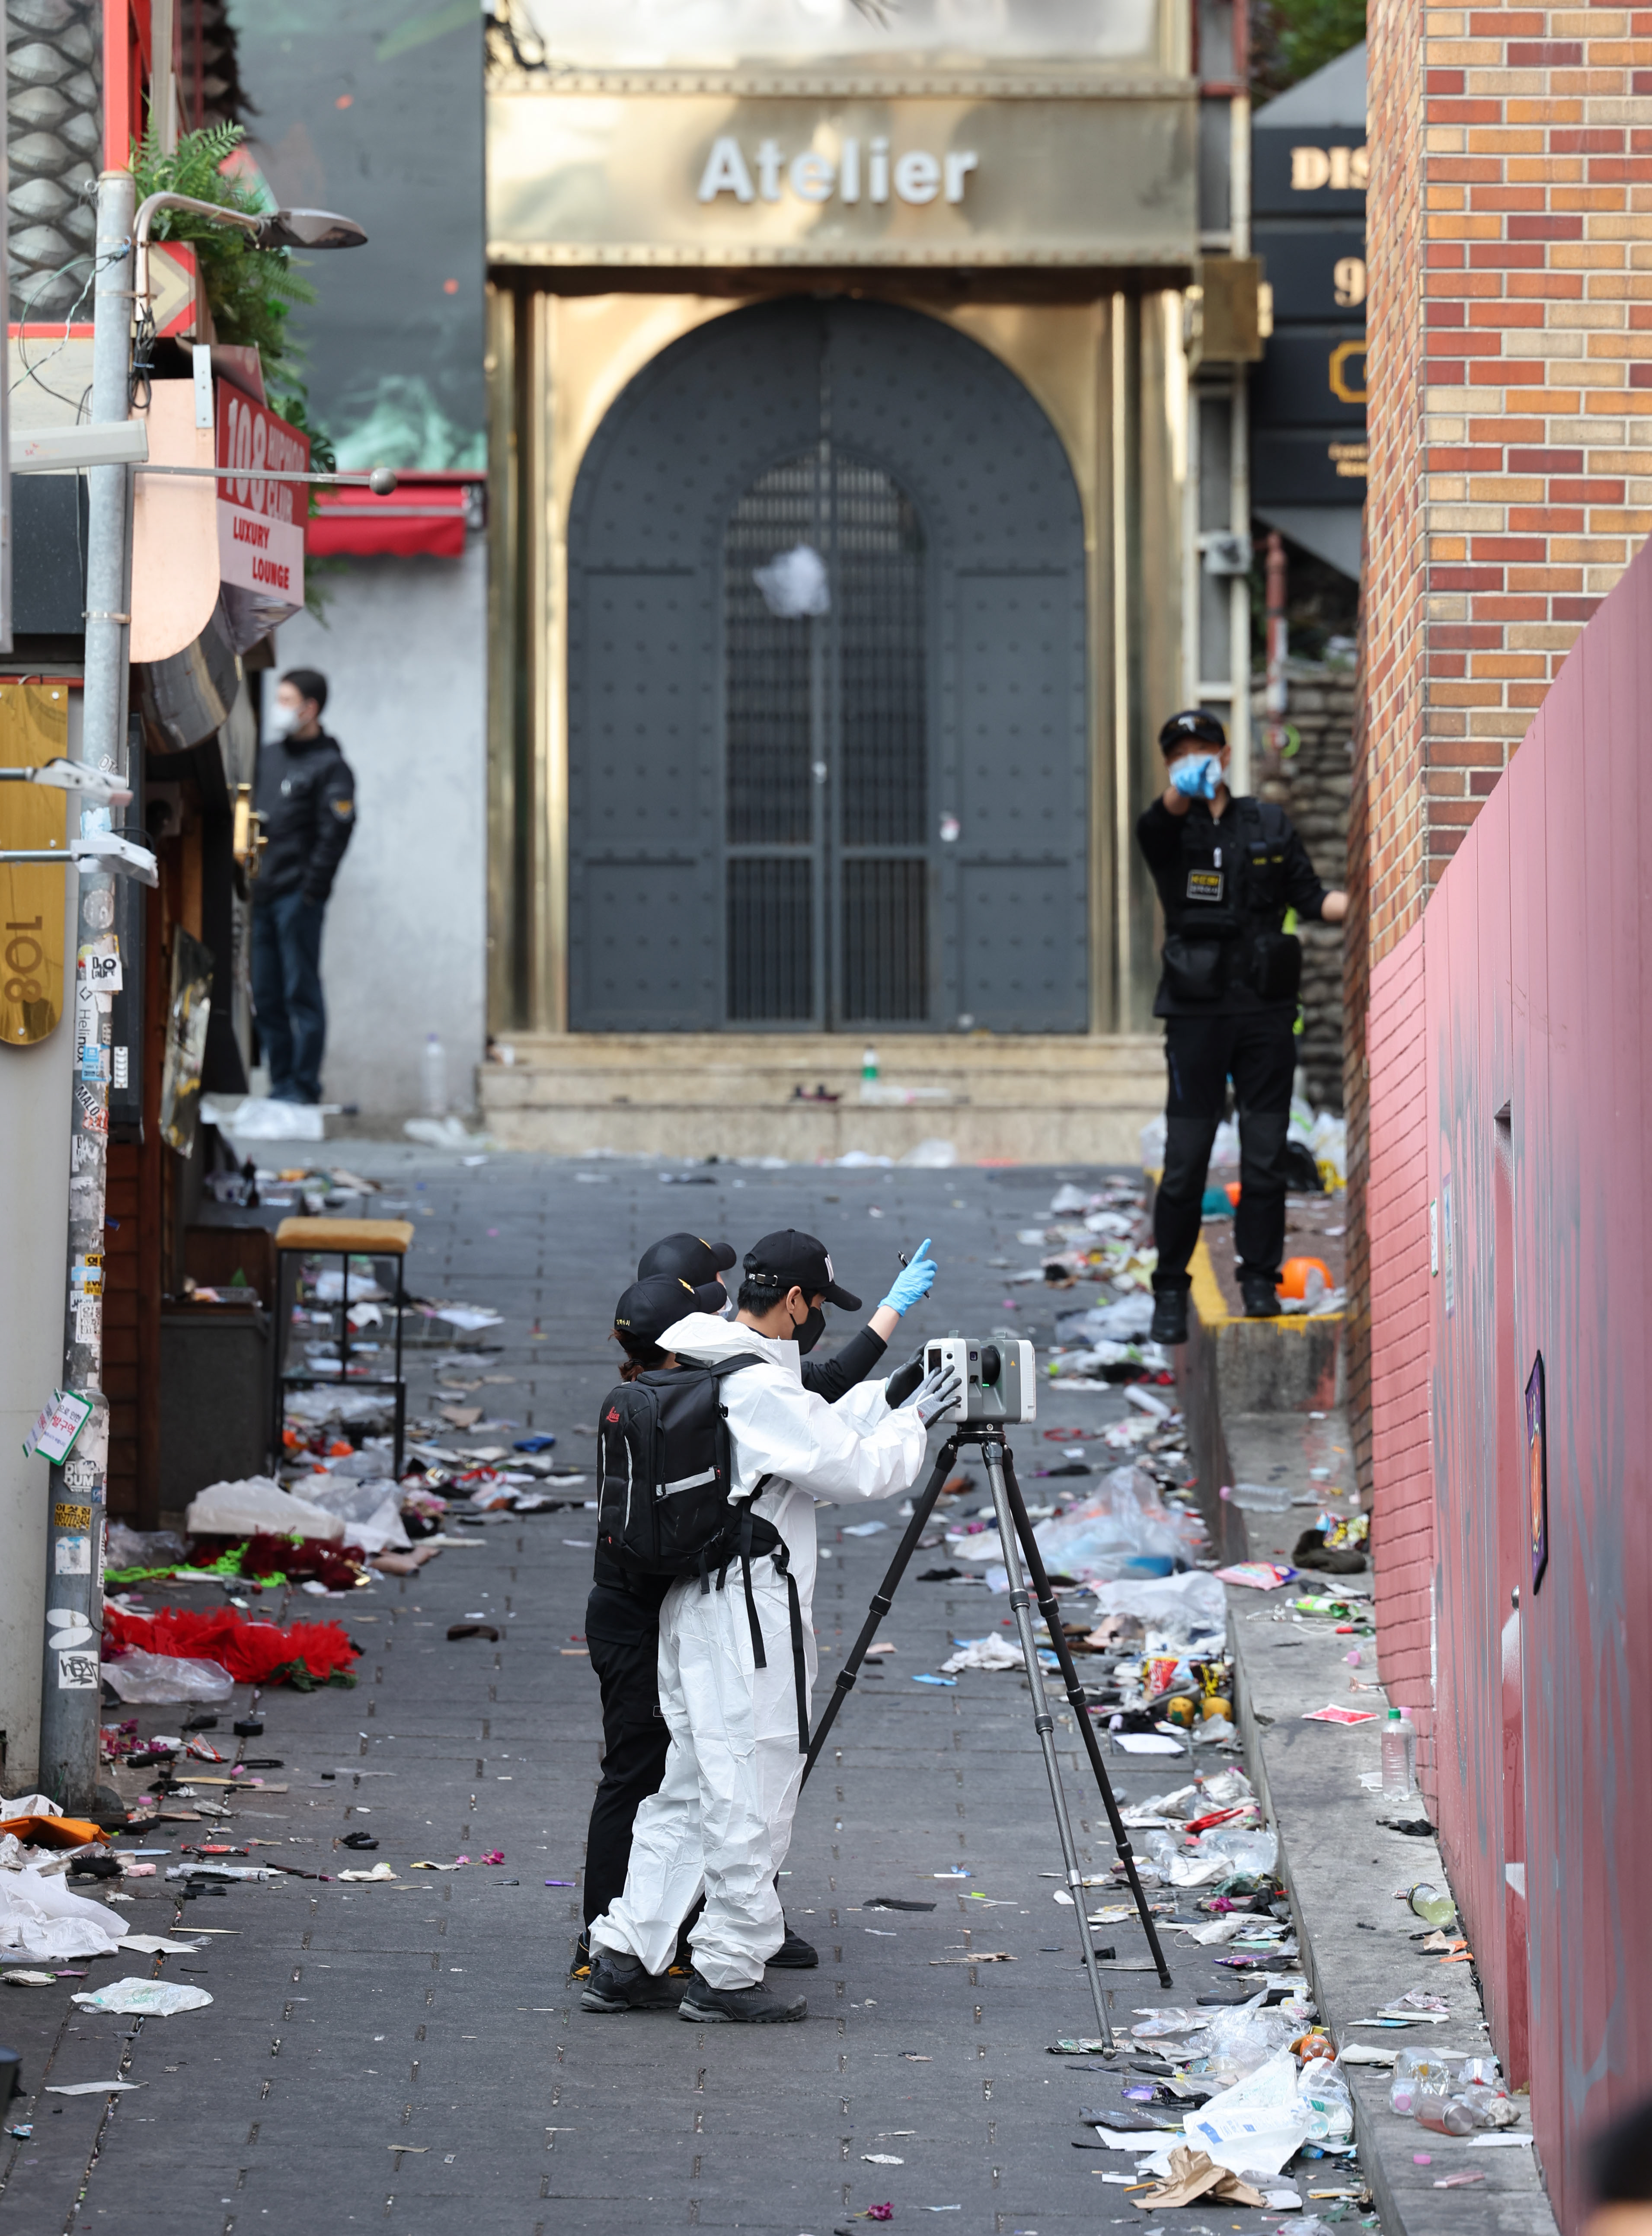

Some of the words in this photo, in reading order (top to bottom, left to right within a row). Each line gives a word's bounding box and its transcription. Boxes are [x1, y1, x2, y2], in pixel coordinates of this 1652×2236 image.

[697, 135, 979, 204] Atelier
[226, 397, 267, 513] 108
[233, 516, 270, 550] LUXURY
[253, 556, 289, 590] LOUNGE
[4, 916, 42, 1003] 108
[77, 1009, 91, 1063] Helinox
[606, 1406, 620, 1422] Leica
[65, 1474, 94, 1487] DUM
